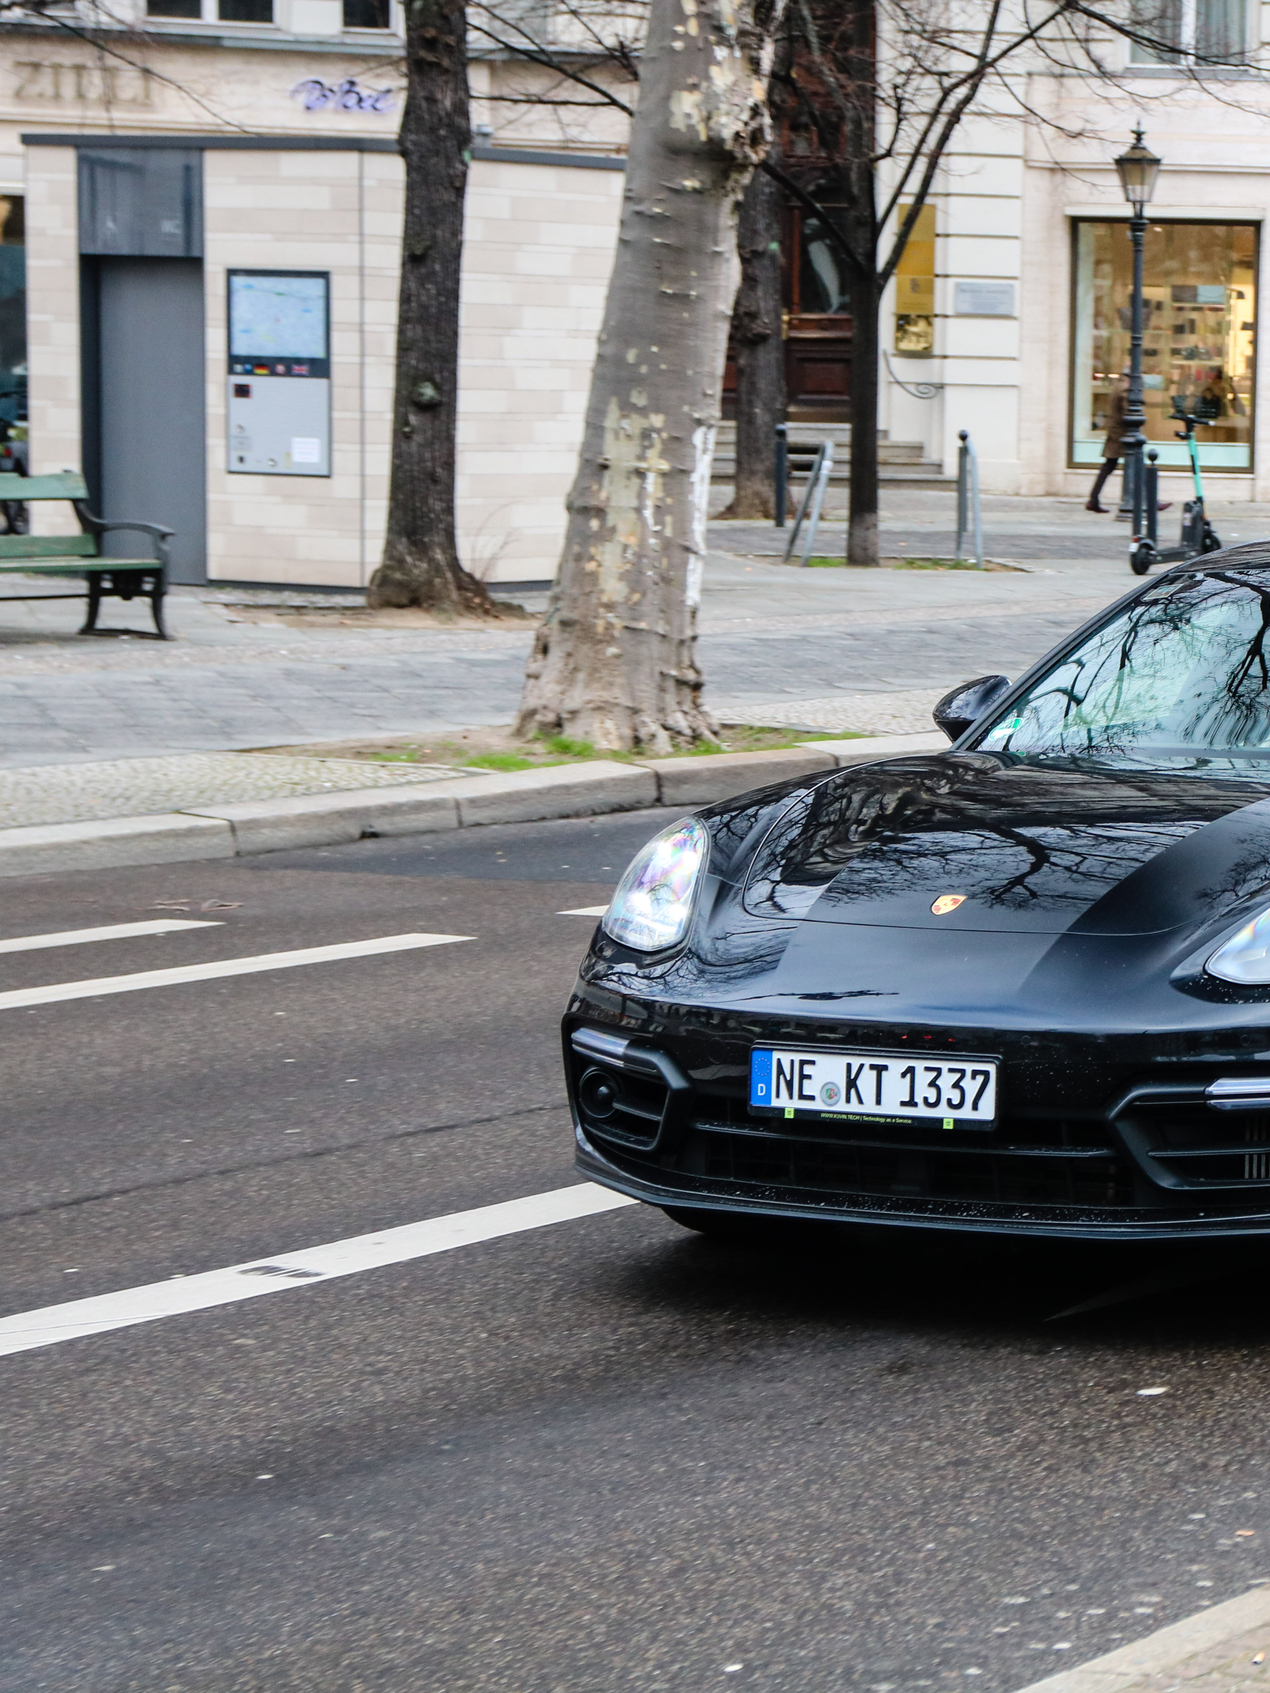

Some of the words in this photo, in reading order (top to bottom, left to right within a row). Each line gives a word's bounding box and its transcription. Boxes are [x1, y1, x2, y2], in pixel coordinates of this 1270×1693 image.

[757, 1083, 767, 1097] D
[775, 1057, 817, 1102] NE
[845, 1062, 889, 1106] KT
[899, 1065, 991, 1112] 1337
[862, 1115, 885, 1123] Technology
